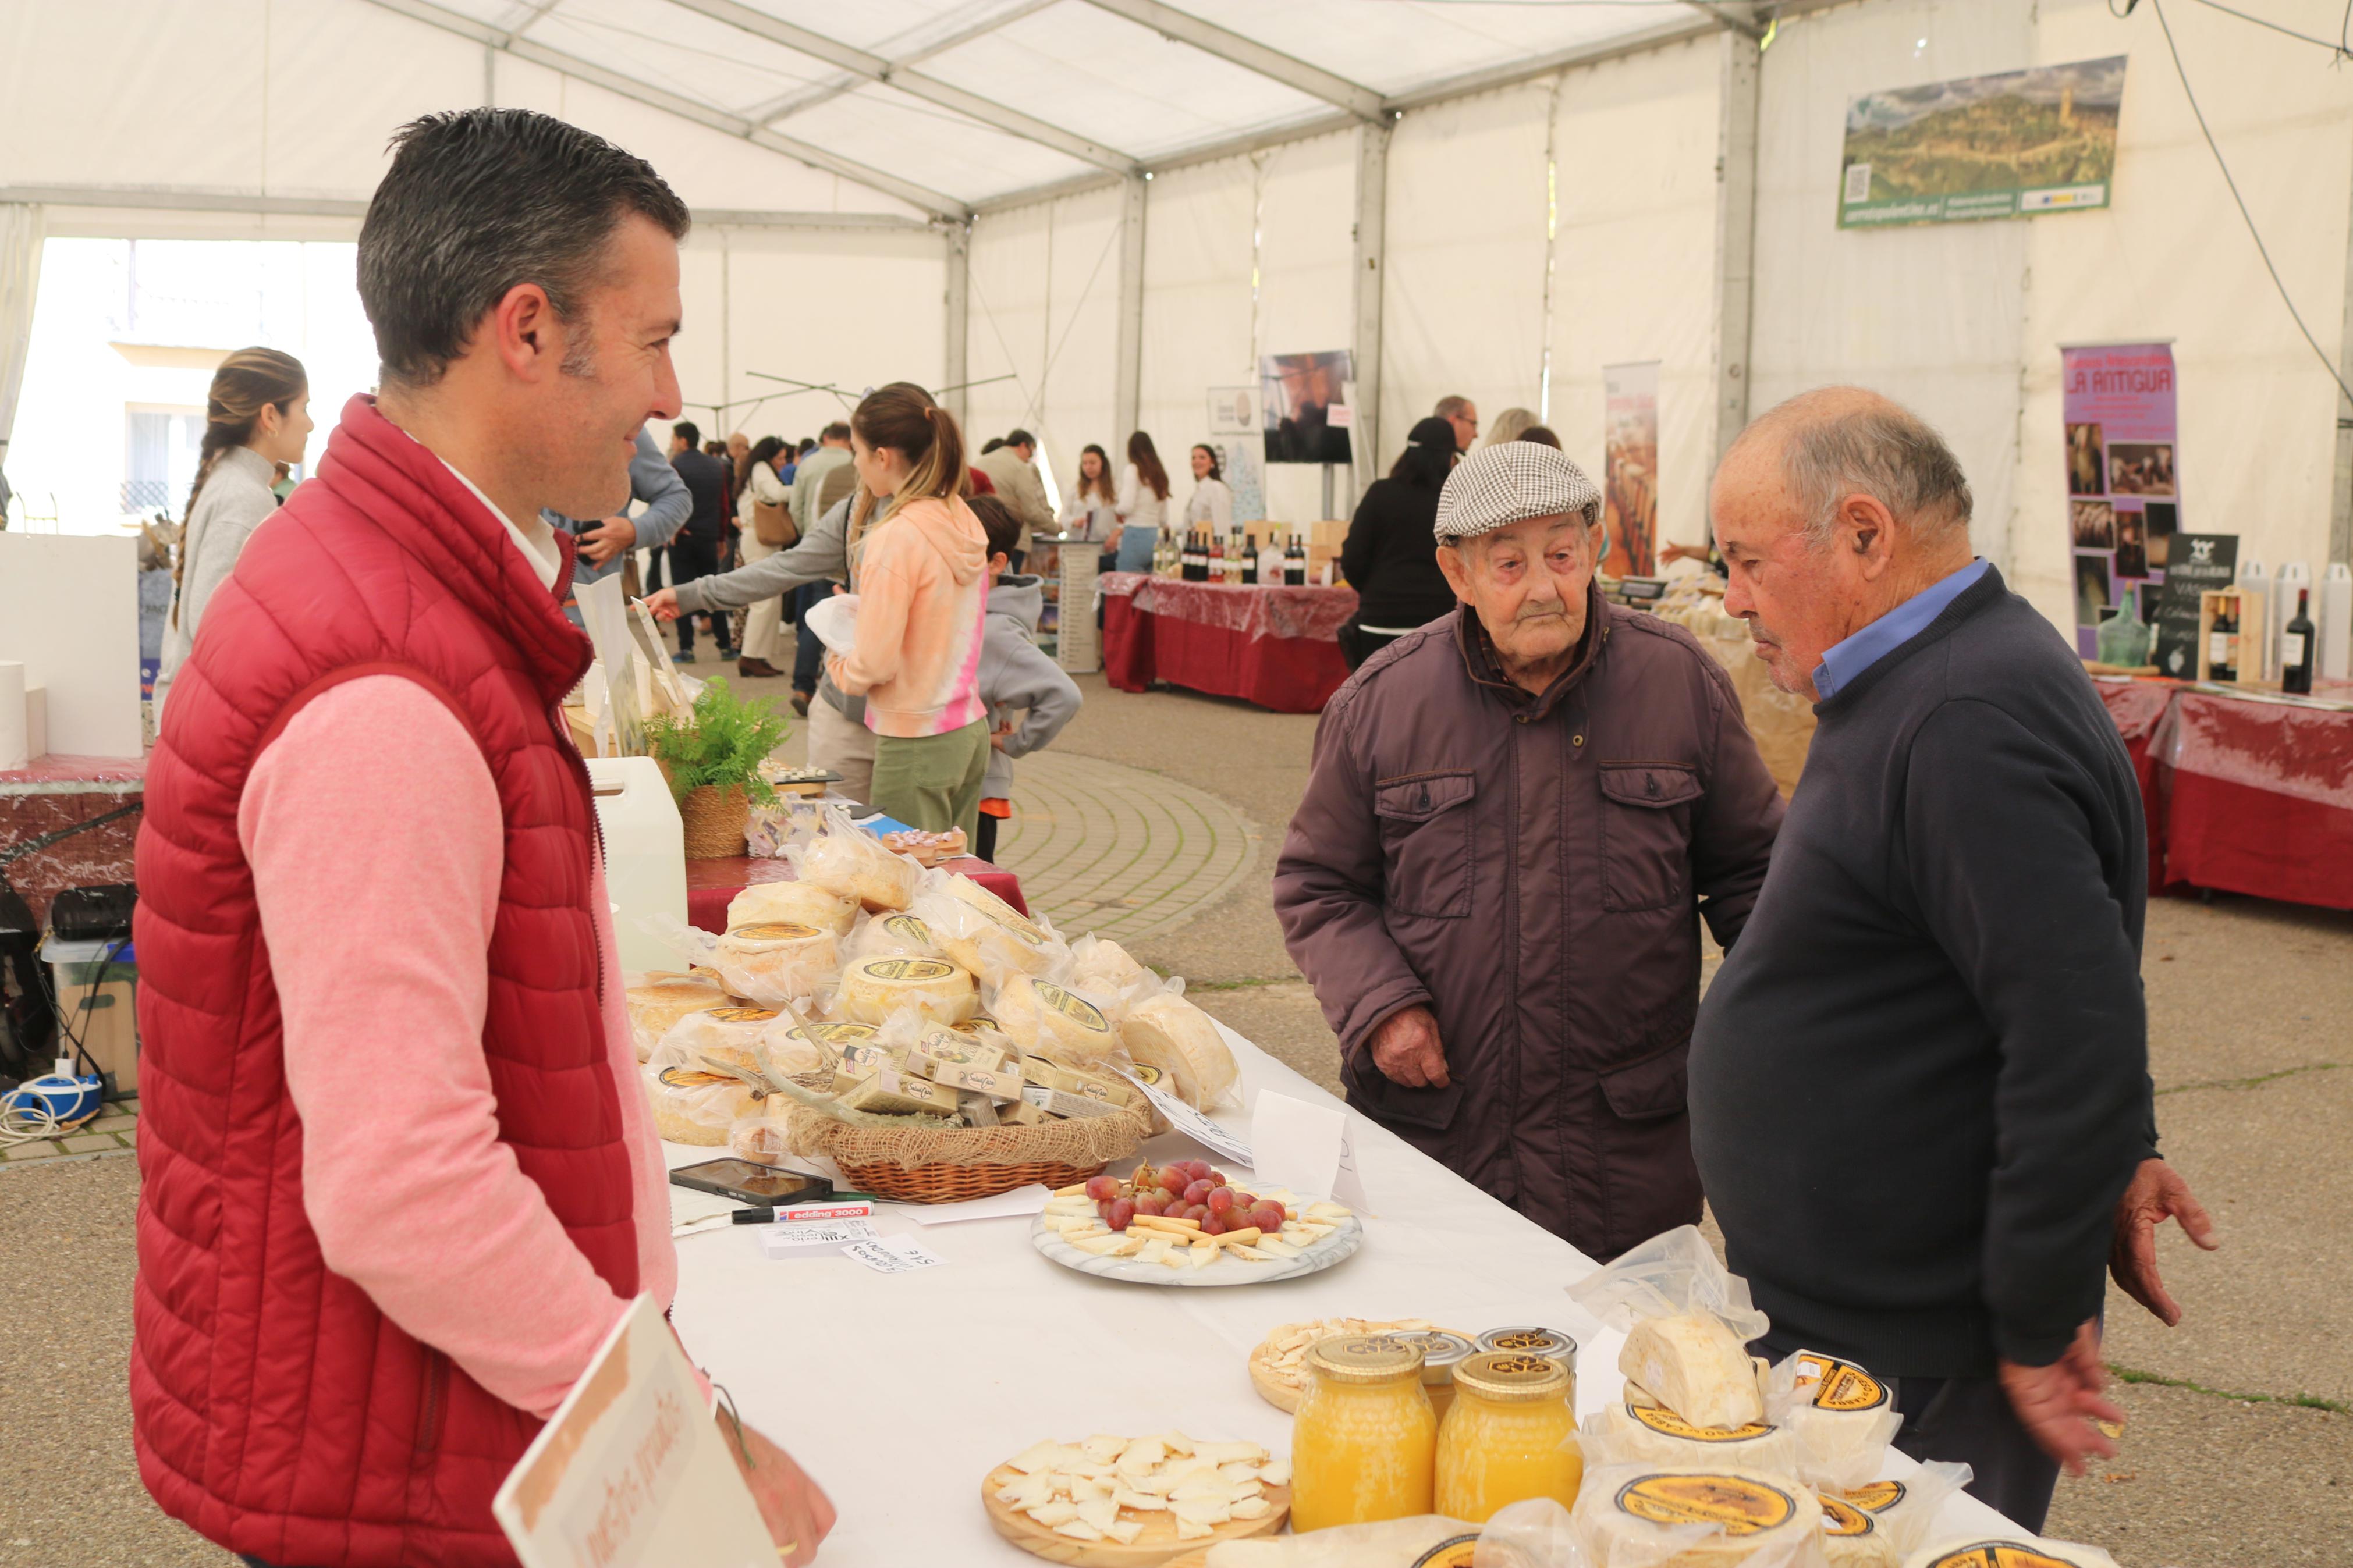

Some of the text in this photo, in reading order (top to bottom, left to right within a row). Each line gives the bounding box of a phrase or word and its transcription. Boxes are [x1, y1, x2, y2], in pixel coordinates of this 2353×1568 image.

[2092, 369, 2171, 393] ANTIGUA
[794, 1208, 863, 1219] edding 3000
[852, 1245, 893, 1268] QUESOS
[1846, 1371, 1873, 1392] QUESO
[1828, 1397, 1867, 1406] CABRA
[1646, 1413, 1684, 1432] CABRA
[1705, 1427, 1751, 1437] QUESO
